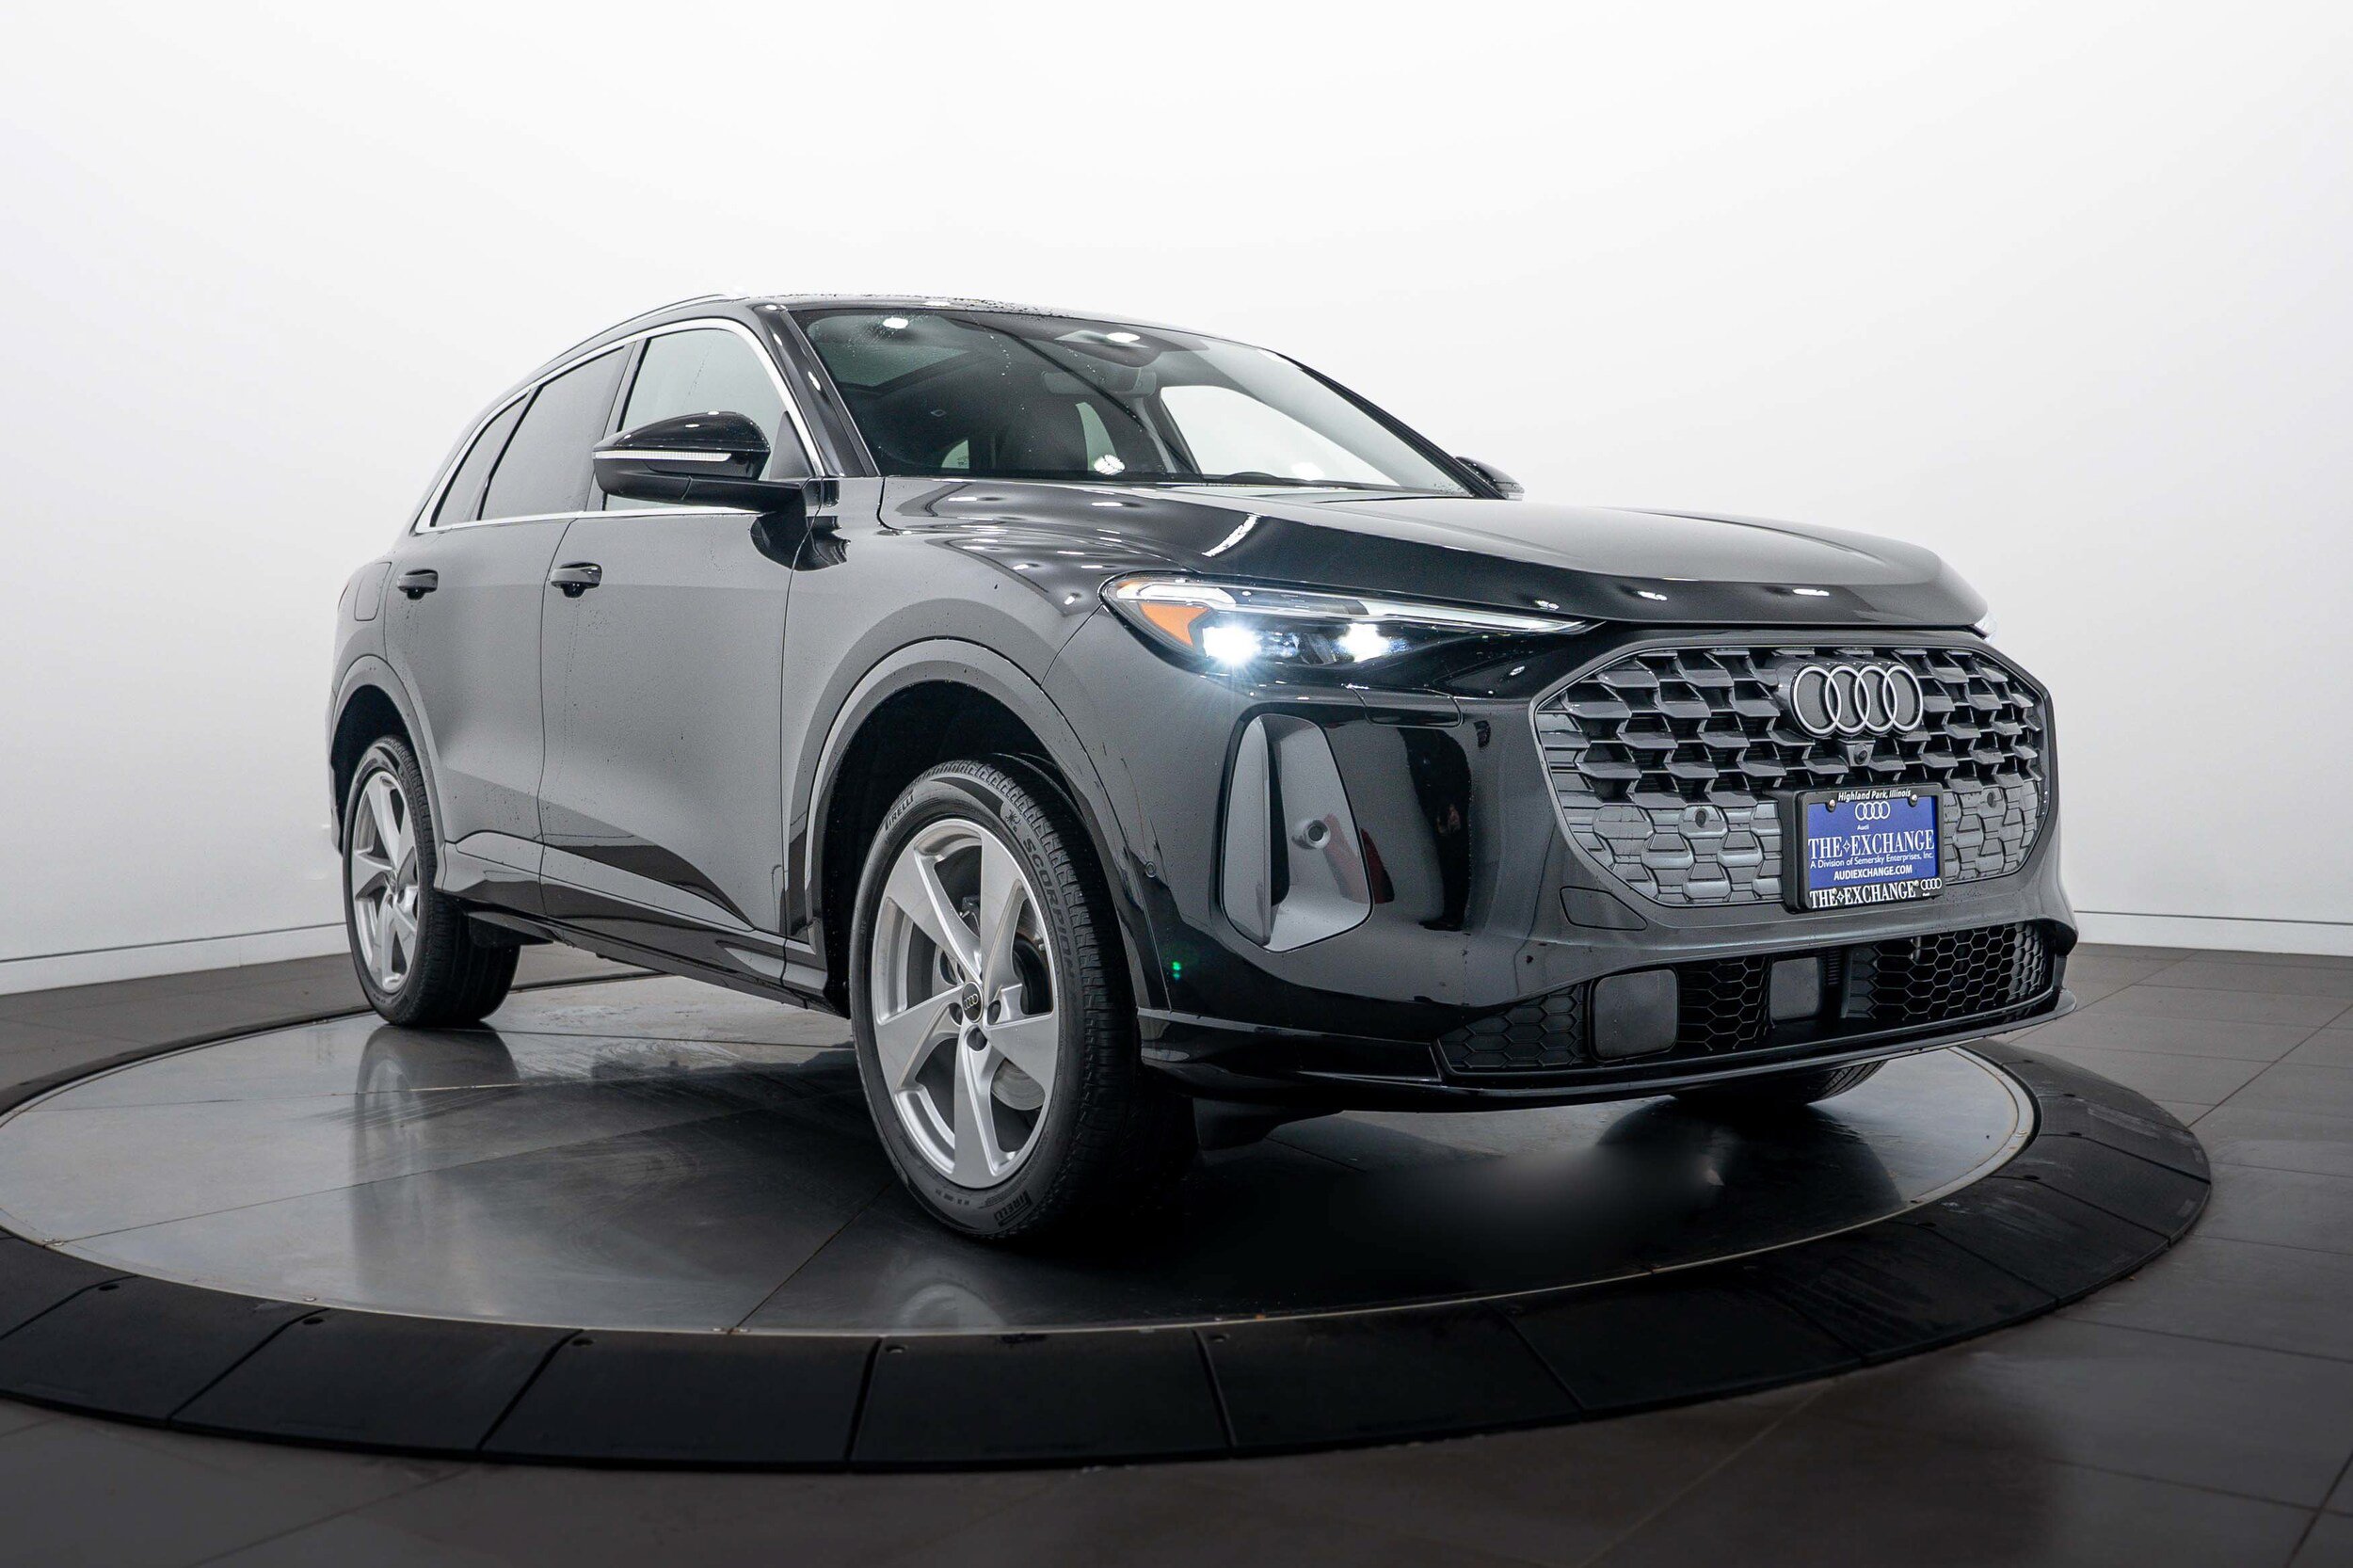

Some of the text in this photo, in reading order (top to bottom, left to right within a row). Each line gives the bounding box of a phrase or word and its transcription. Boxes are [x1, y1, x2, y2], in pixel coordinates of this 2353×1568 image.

[1838, 788, 1912, 802] Highland Park, Illinois
[885, 792, 914, 830] PIRELLI
[1808, 829, 1934, 859] THE EXCHANGE
[1818, 859, 1844, 868] Division
[1846, 857, 1853, 866] of
[1854, 855, 1885, 865] Semersky
[1923, 851, 1934, 859] Inc.
[1834, 865, 1913, 880] AUDIEXCHANGE.COM
[1809, 881, 1915, 909] THE EXCHANGE
[993, 1190, 1032, 1227] PIRELLI
